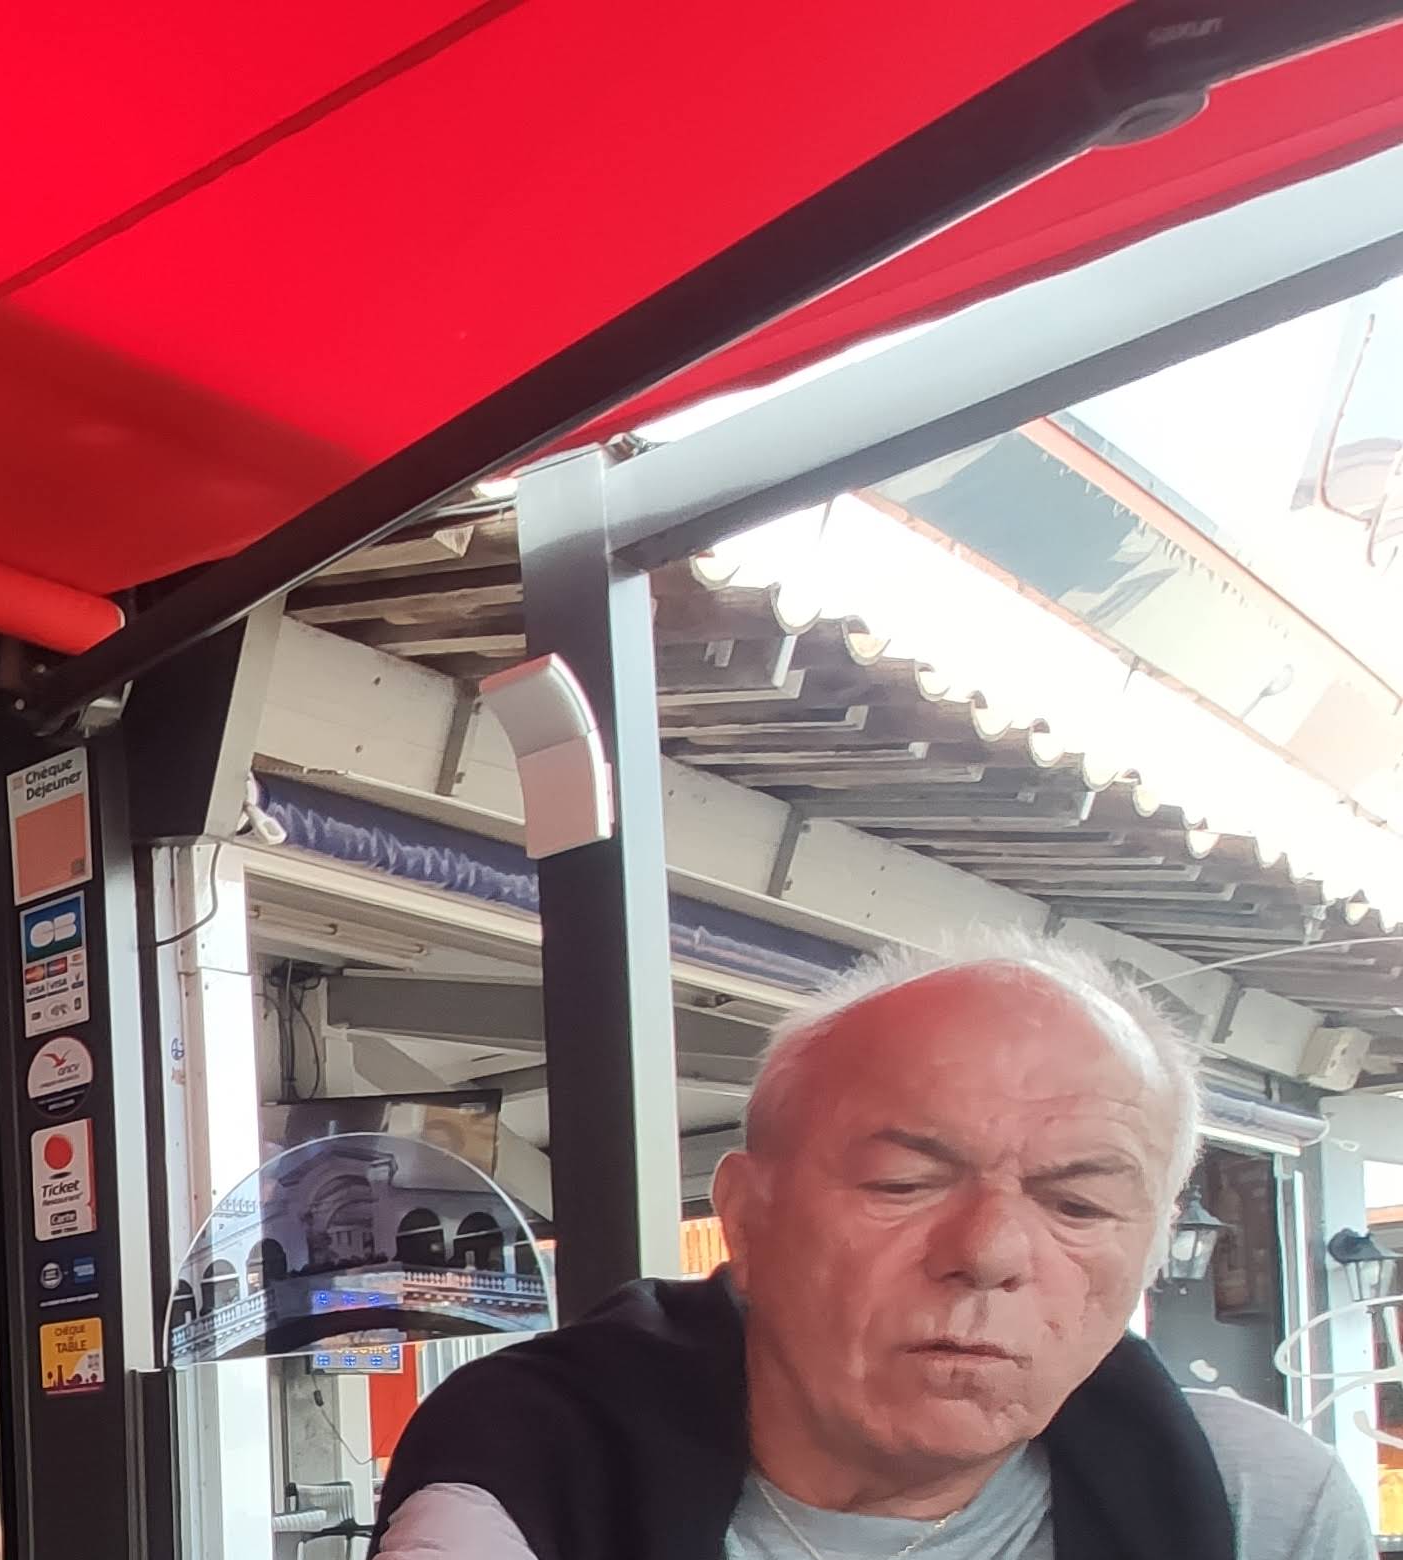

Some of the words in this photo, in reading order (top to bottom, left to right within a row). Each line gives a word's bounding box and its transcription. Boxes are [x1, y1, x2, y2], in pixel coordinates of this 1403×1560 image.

[25, 759, 74, 785] Chèque
[26, 770, 82, 801] Déjeuner
[42, 1180, 81, 1198] Ticket
[55, 1340, 89, 1354] TABLE
